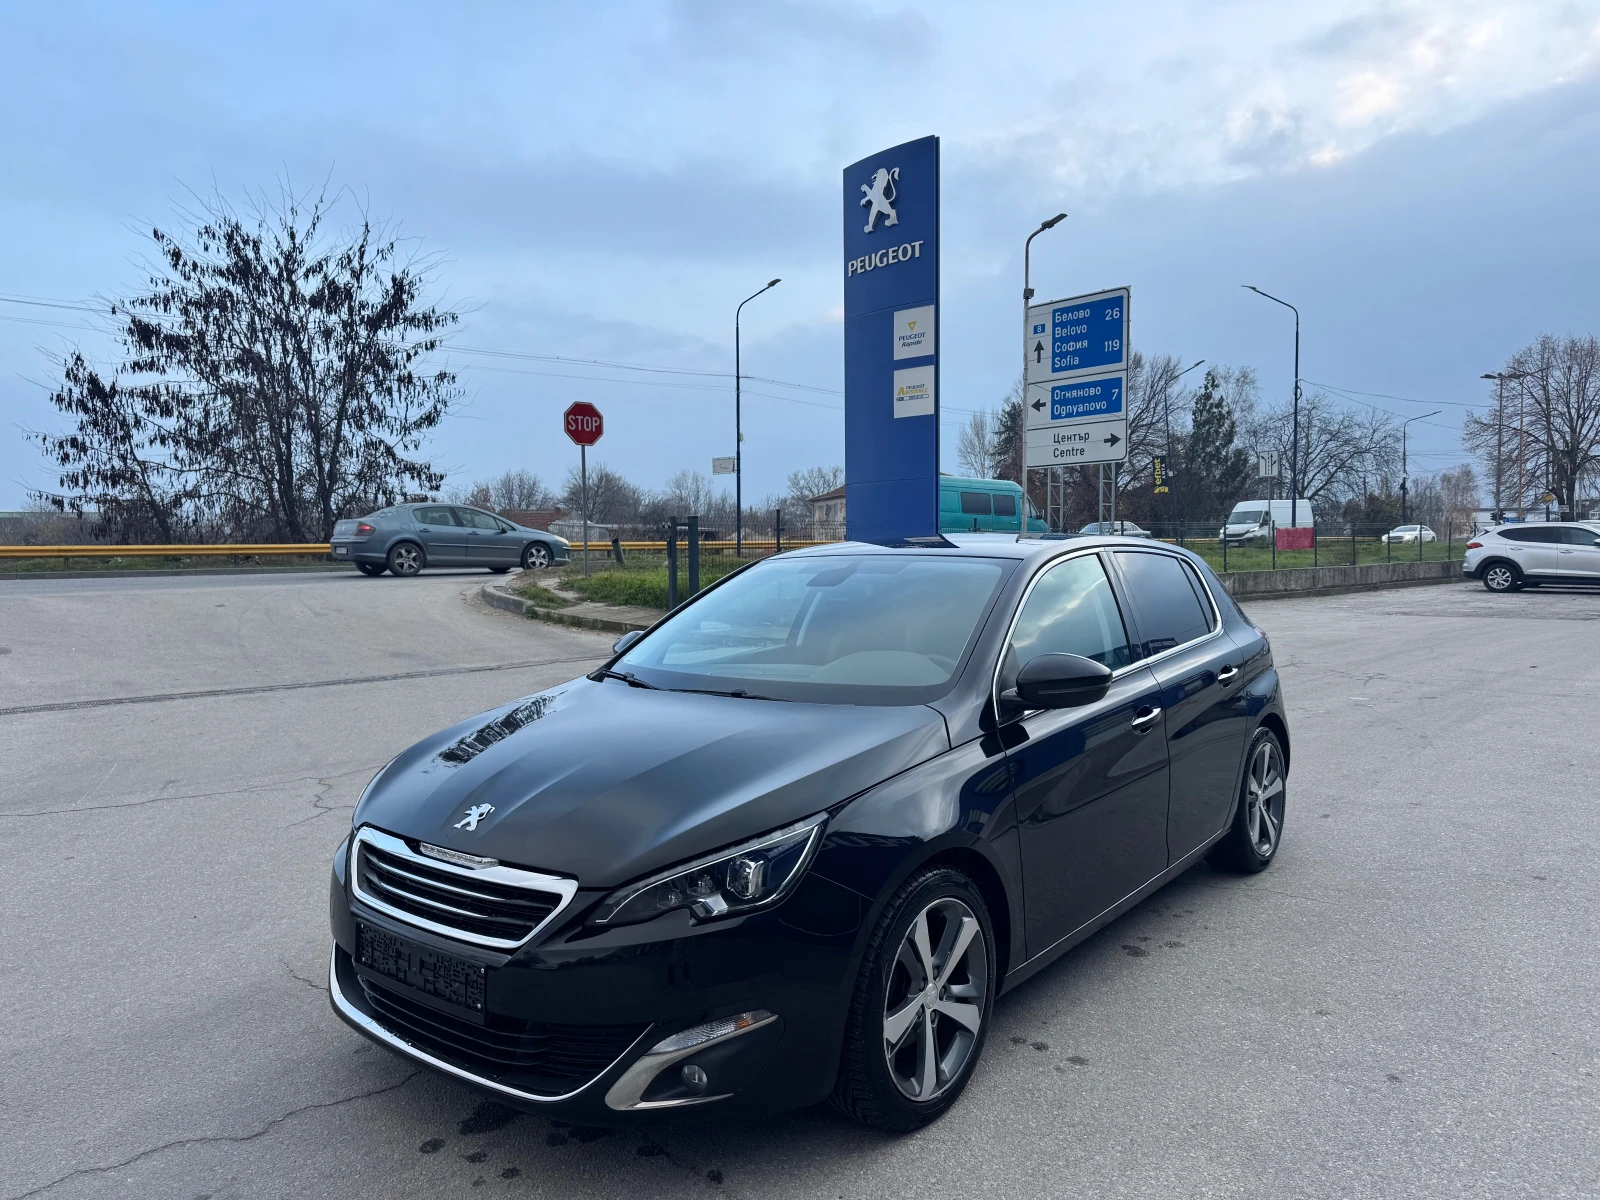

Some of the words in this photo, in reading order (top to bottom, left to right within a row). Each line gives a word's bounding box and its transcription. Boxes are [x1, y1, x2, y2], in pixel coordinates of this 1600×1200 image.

[848, 240, 924, 277] PEUGEOT
[1055, 308, 1091, 323] Белово
[1105, 307, 1120, 320] 26
[1036, 325, 1042, 333] 8
[1055, 324, 1088, 338] Belovo
[898, 332, 926, 341] PEUGEOT
[1054, 339, 1088, 353] София
[1104, 339, 1120, 352] 119
[1054, 355, 1079, 368] Sofia
[1054, 386, 1102, 401] Огняново
[1111, 388, 1119, 401] 7
[1053, 401, 1107, 416] Ognyanovo
[568, 415, 600, 432] STOP
[1053, 432, 1090, 444] Център
[1053, 446, 1085, 458] Centre
